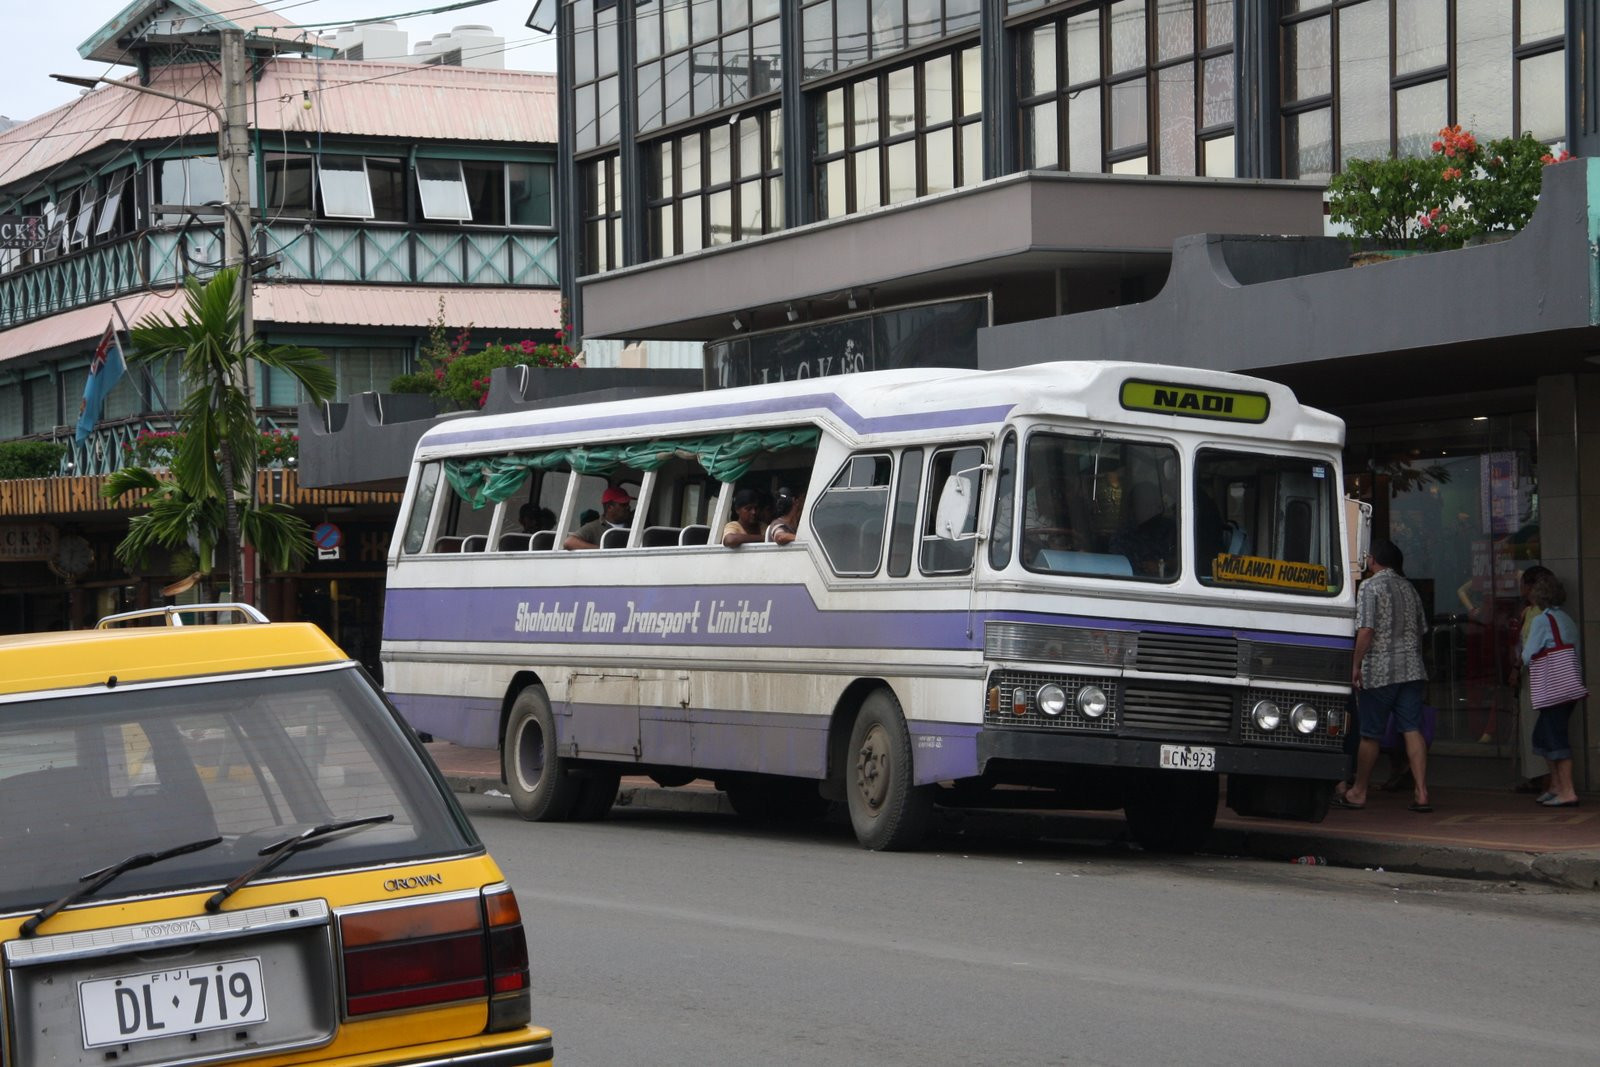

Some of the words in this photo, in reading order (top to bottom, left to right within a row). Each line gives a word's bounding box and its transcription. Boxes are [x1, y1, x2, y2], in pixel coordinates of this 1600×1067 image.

[1153, 389, 1235, 413] NADI
[0, 531, 51, 546] CK'S
[1221, 557, 1276, 579] MALAWAI
[1278, 564, 1325, 587] HOUSING
[515, 601, 579, 633] Shahabud
[582, 601, 616, 633] Dean
[622, 600, 701, 638] Transport
[707, 600, 773, 634] Limited.
[383, 873, 443, 891] CROWN
[141, 920, 201, 939] TOYOTA
[151, 970, 190, 984] FIJI
